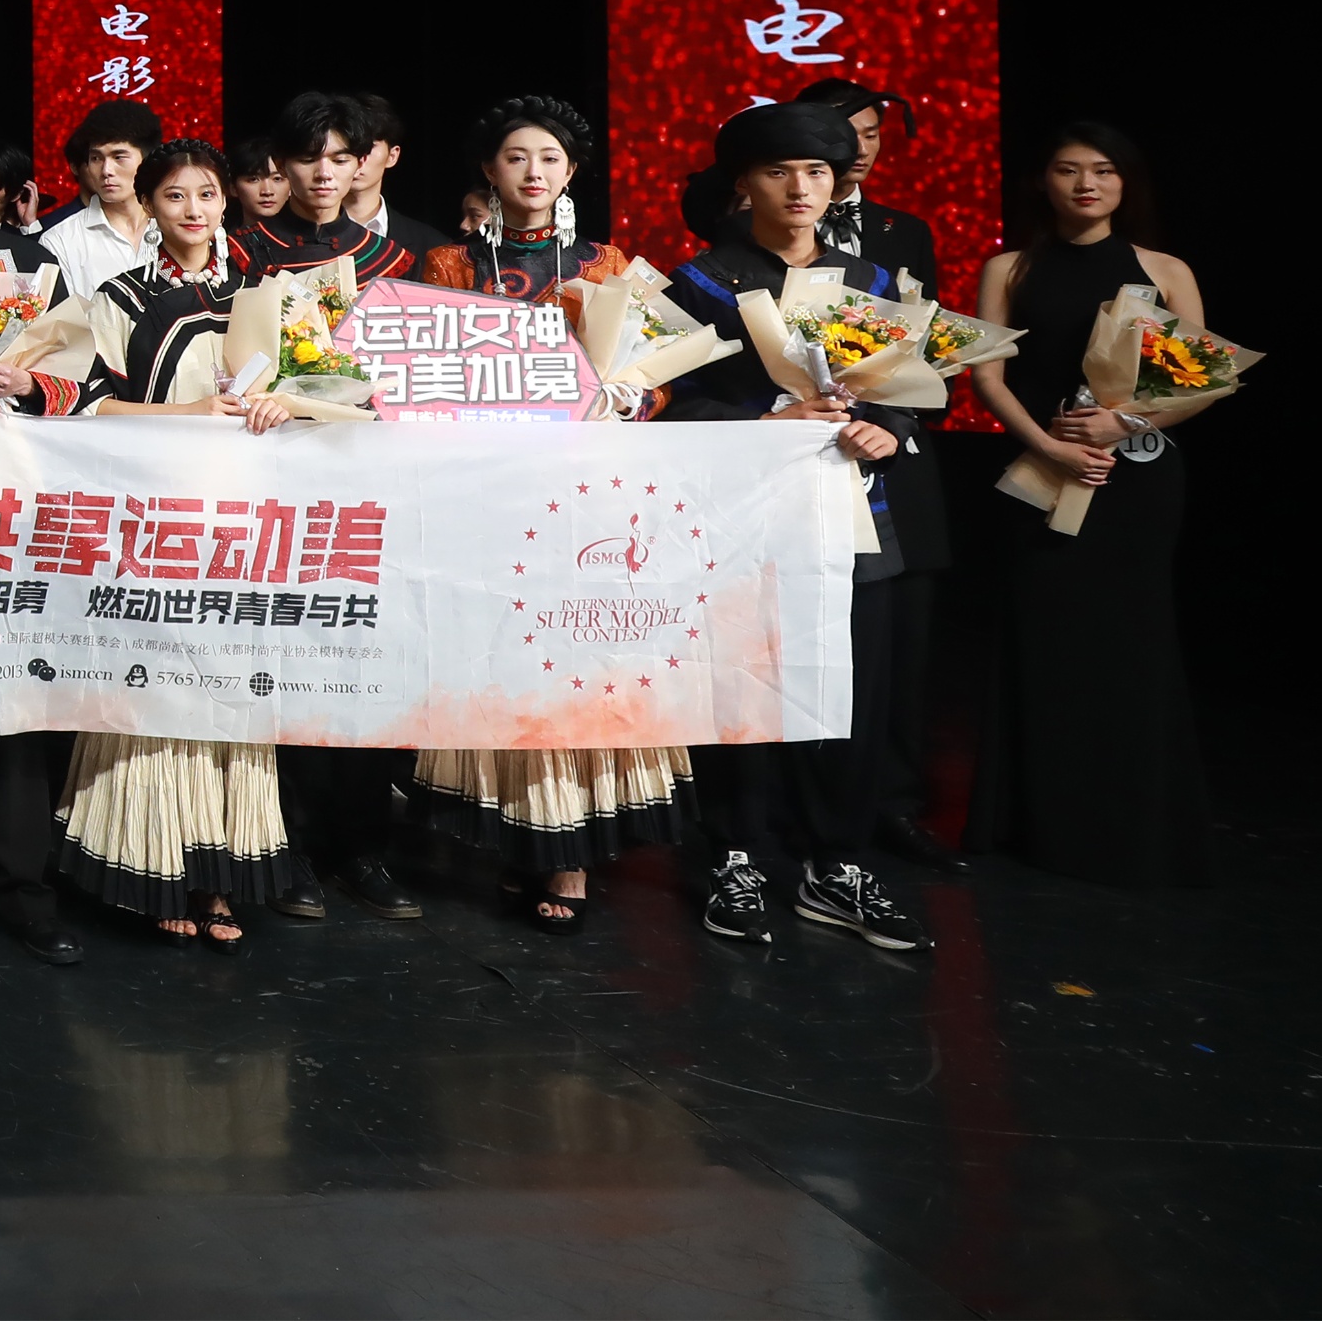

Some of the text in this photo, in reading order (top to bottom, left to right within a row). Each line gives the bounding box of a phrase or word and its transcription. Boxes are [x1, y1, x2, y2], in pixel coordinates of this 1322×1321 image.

[351, 302, 568, 352] 运动女神
[360, 351, 581, 404] 为美加冕
[1124, 432, 1158, 453] 10
[84, 585, 379, 629] 燃动世界青春与共
[561, 598, 669, 611] INTERNATIONAL
[535, 607, 686, 629] SUPER MODEL
[572, 628, 652, 643] CONTEST
[60, 663, 113, 682] ismccn
